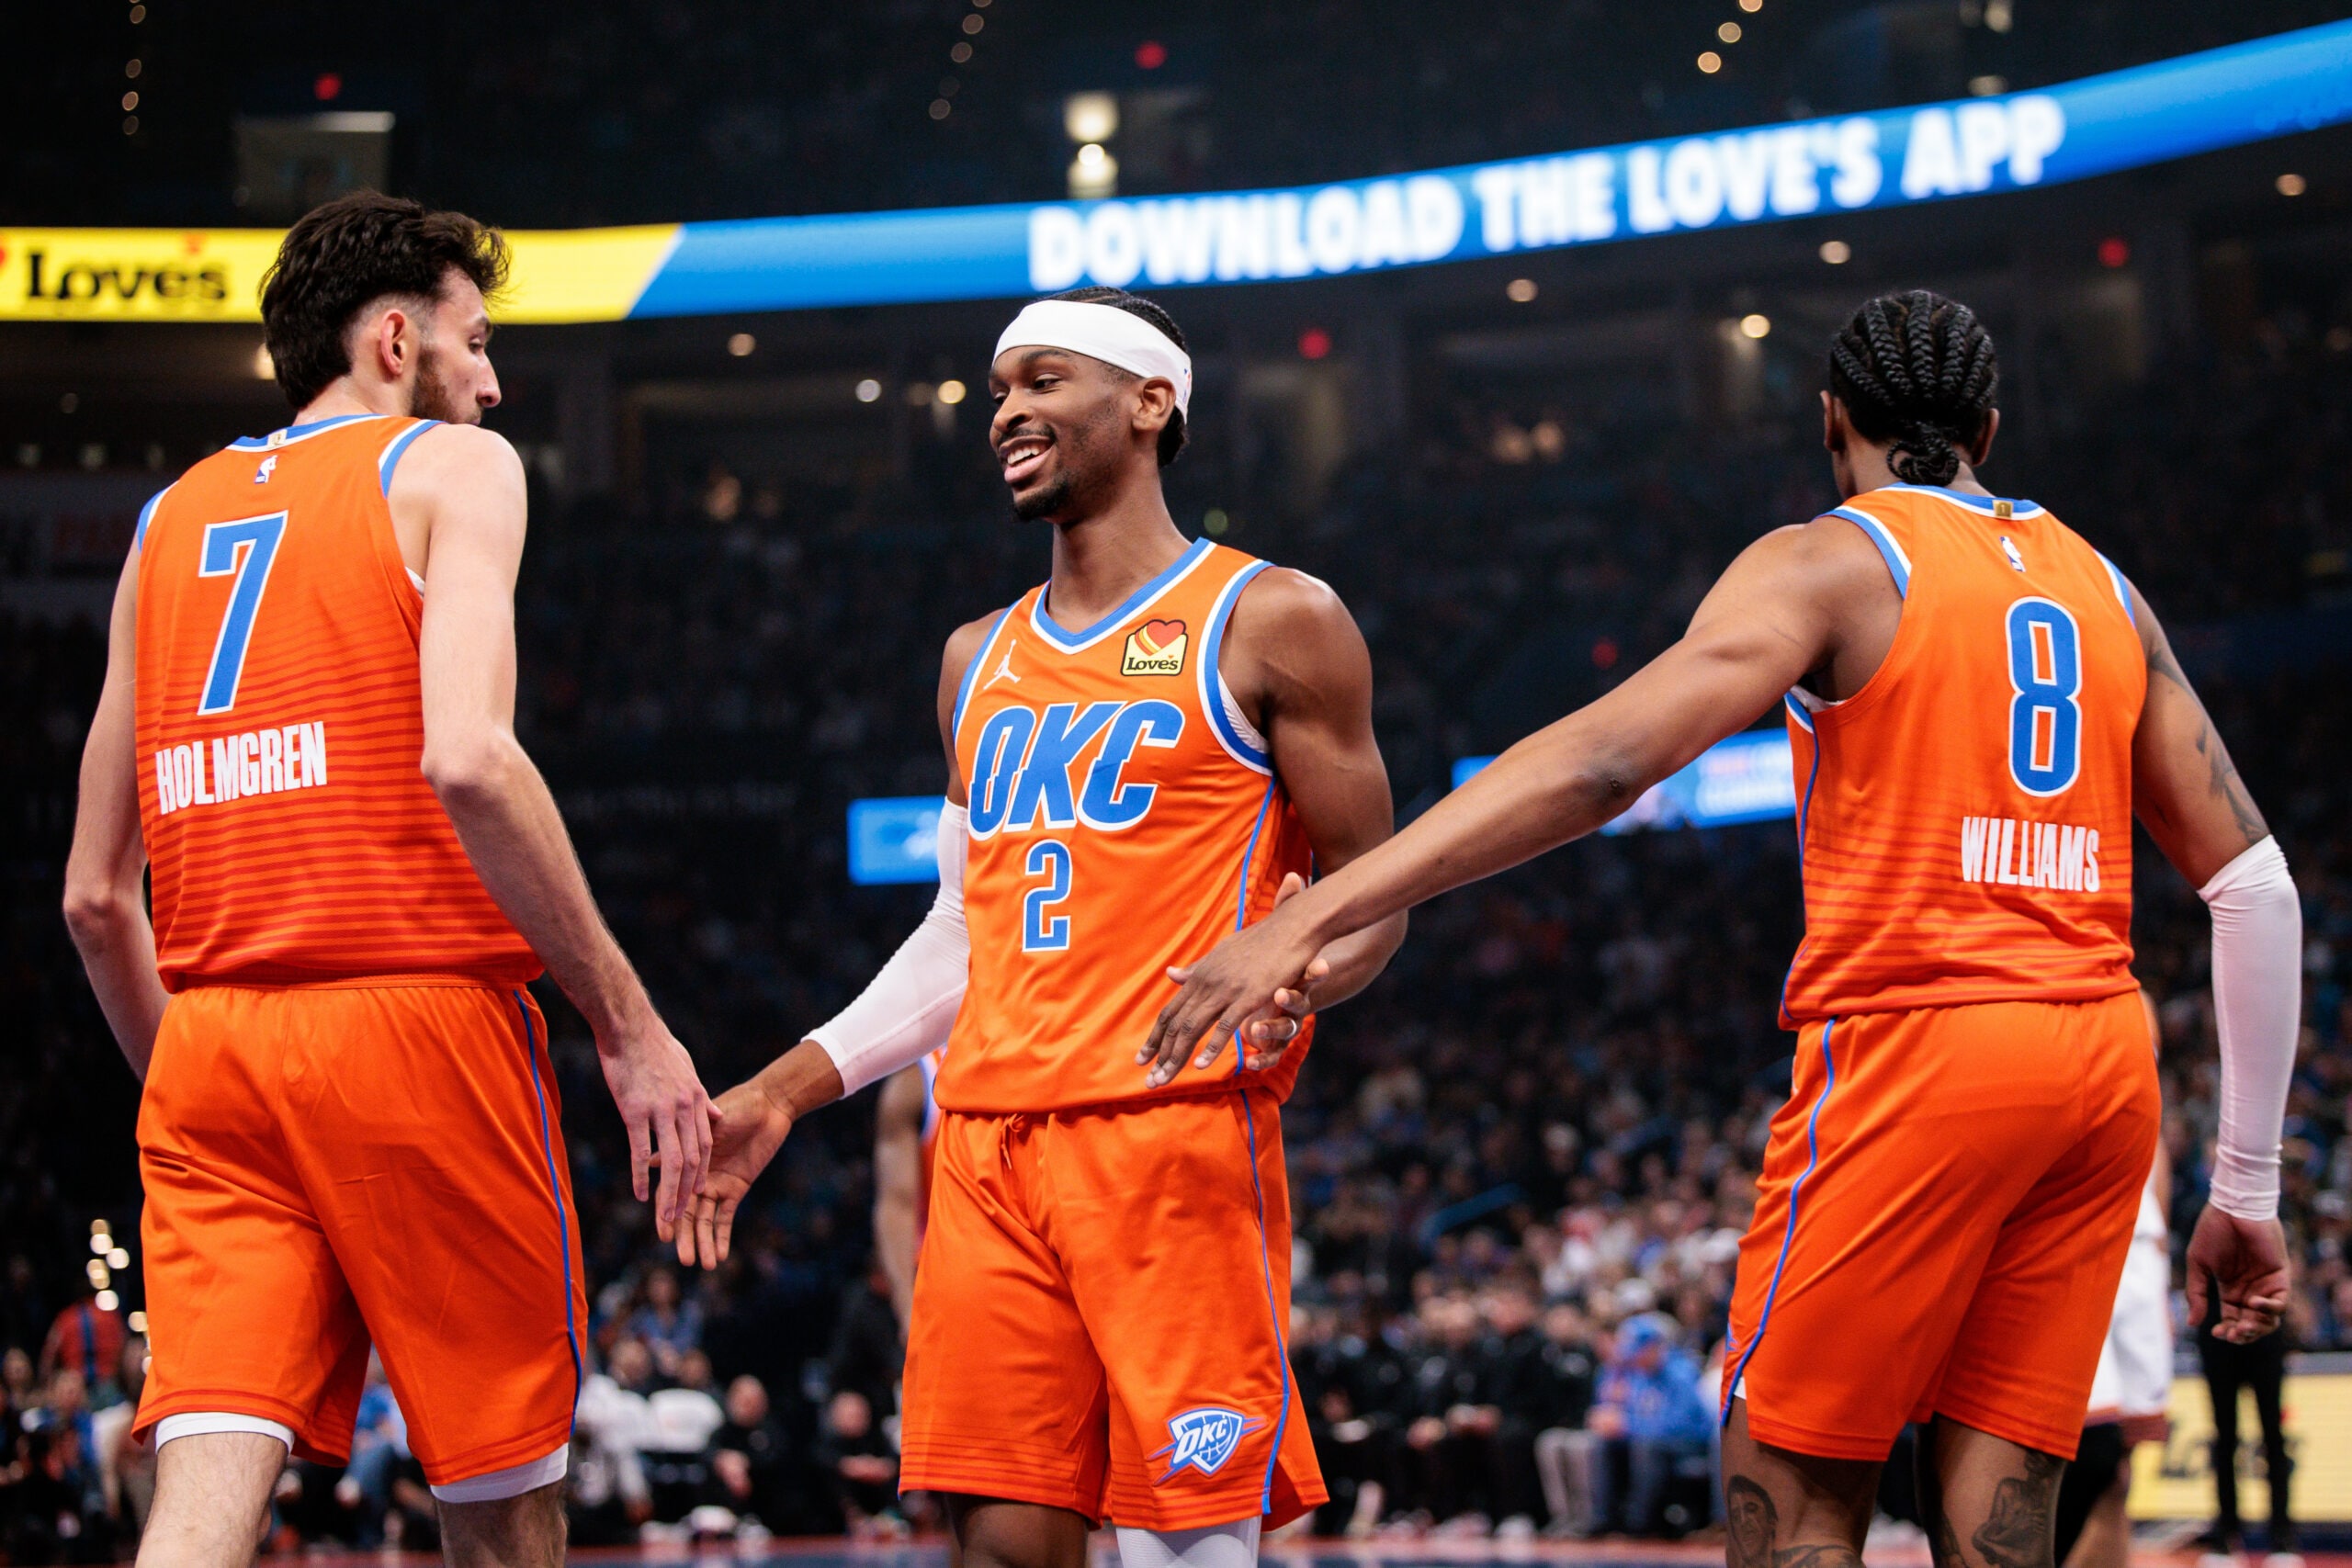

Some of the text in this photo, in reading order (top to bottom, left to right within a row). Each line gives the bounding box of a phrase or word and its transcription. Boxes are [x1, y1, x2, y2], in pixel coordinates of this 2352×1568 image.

[1028, 95, 2066, 291] DOWNLOAD THE LOVE'S APP
[198, 511, 288, 716] 7
[2005, 595, 2082, 797] 8
[155, 721, 327, 815] HOLMGREN
[967, 698, 1186, 841] OKC
[1022, 839, 1073, 953] 2
[1961, 816, 2100, 893] WILLIAMS
[1172, 1419, 1227, 1465] OKC
